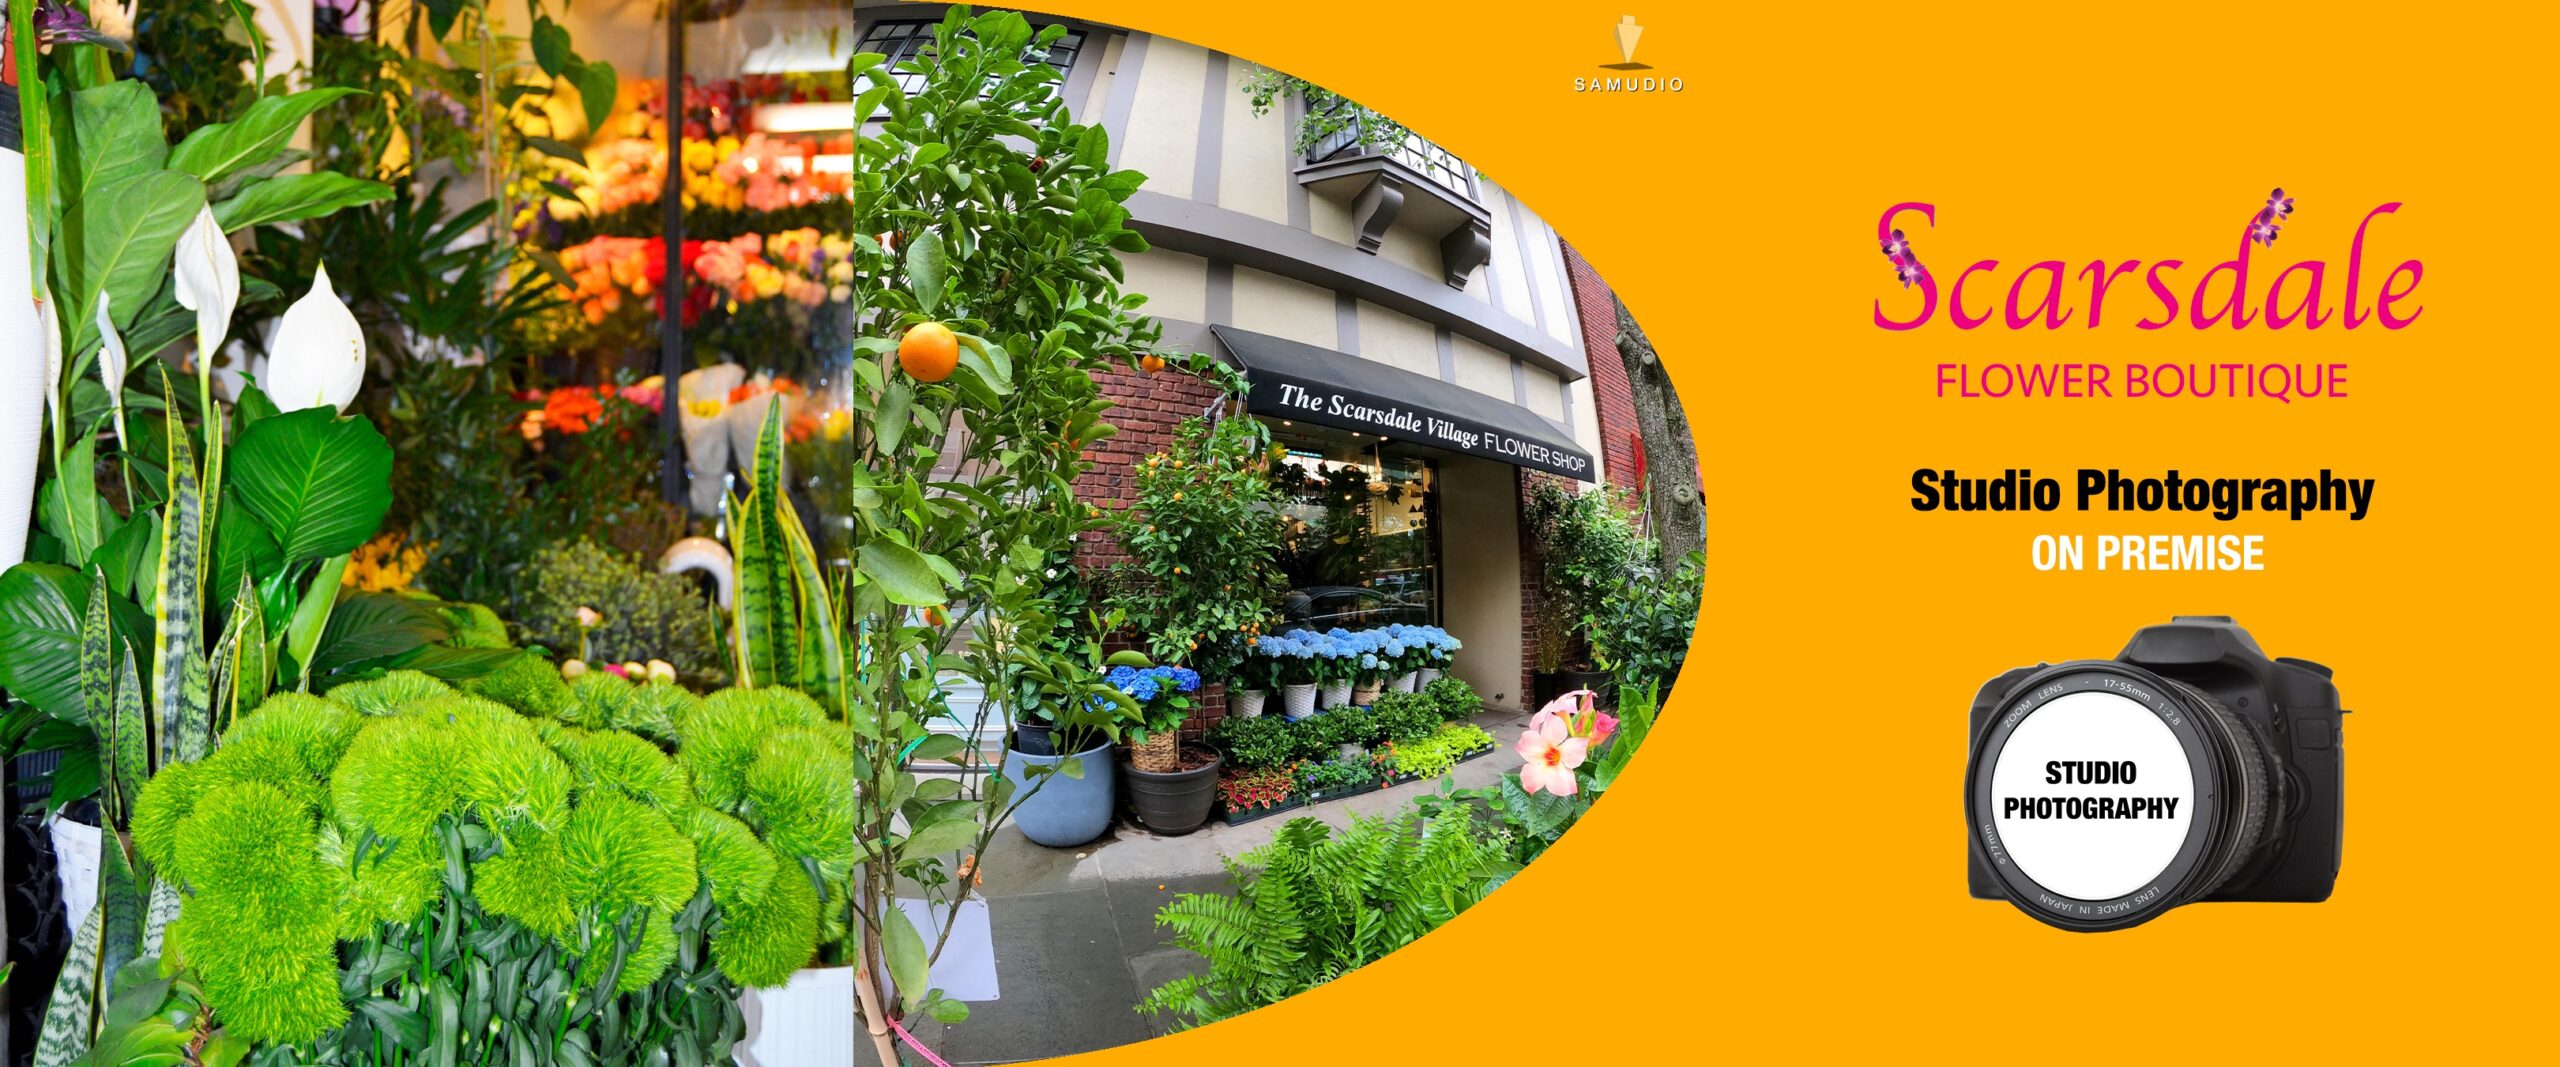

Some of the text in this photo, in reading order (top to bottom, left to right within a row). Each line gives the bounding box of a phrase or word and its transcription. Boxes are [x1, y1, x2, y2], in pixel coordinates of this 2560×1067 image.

[1279, 383, 1586, 472] The Scarsdale Village FLOWER SHOP
[2003, 700, 2033, 728] ZOOM
[2037, 682, 2064, 700] LENS
[2103, 678, 2151, 702] 17-55mm
[2157, 702, 2181, 726] 1:2.8
[2039, 886, 2160, 915] LENS MADE IN JAPAN
